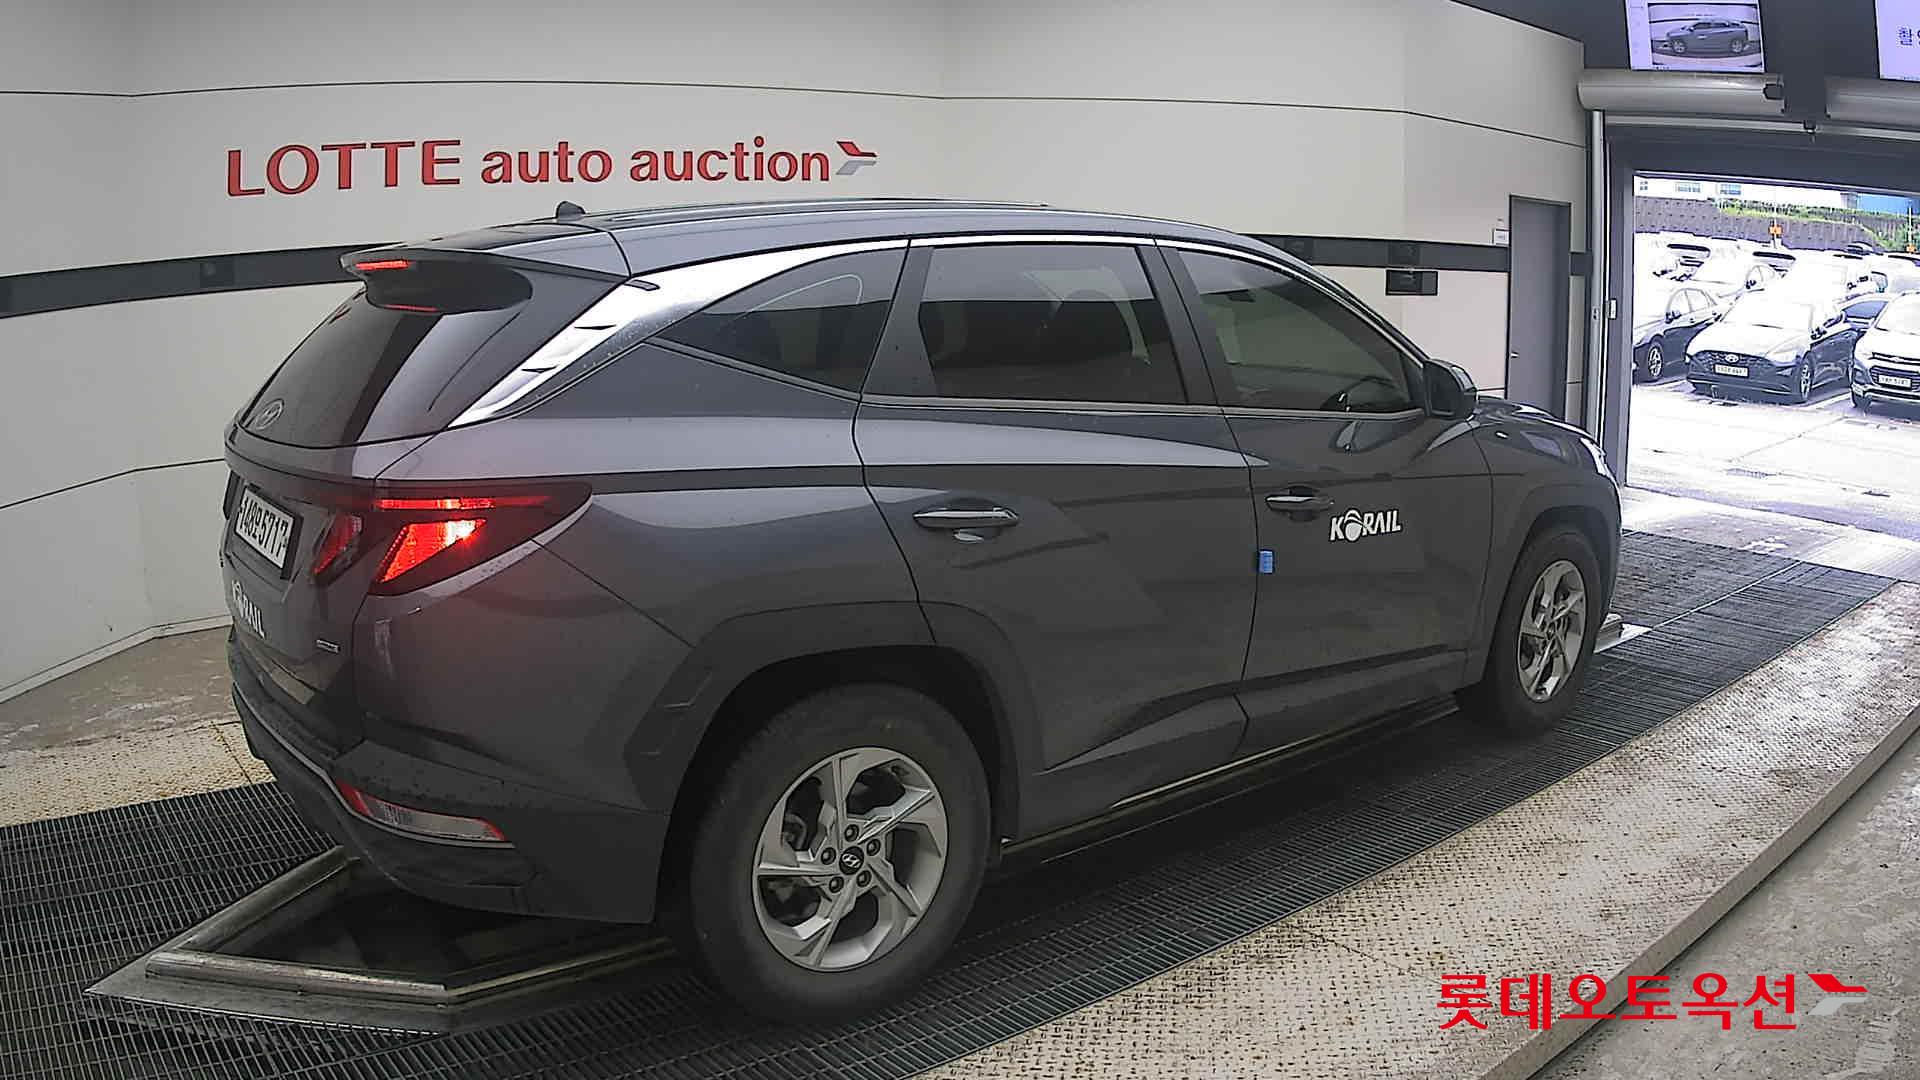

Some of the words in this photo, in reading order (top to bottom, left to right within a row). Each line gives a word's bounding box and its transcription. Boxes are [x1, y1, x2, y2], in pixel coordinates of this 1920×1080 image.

[226, 140, 460, 197] LOTTE
[480, 141, 612, 184] auto
[629, 136, 831, 182] auction
[1330, 509, 1401, 541] KORAIL
